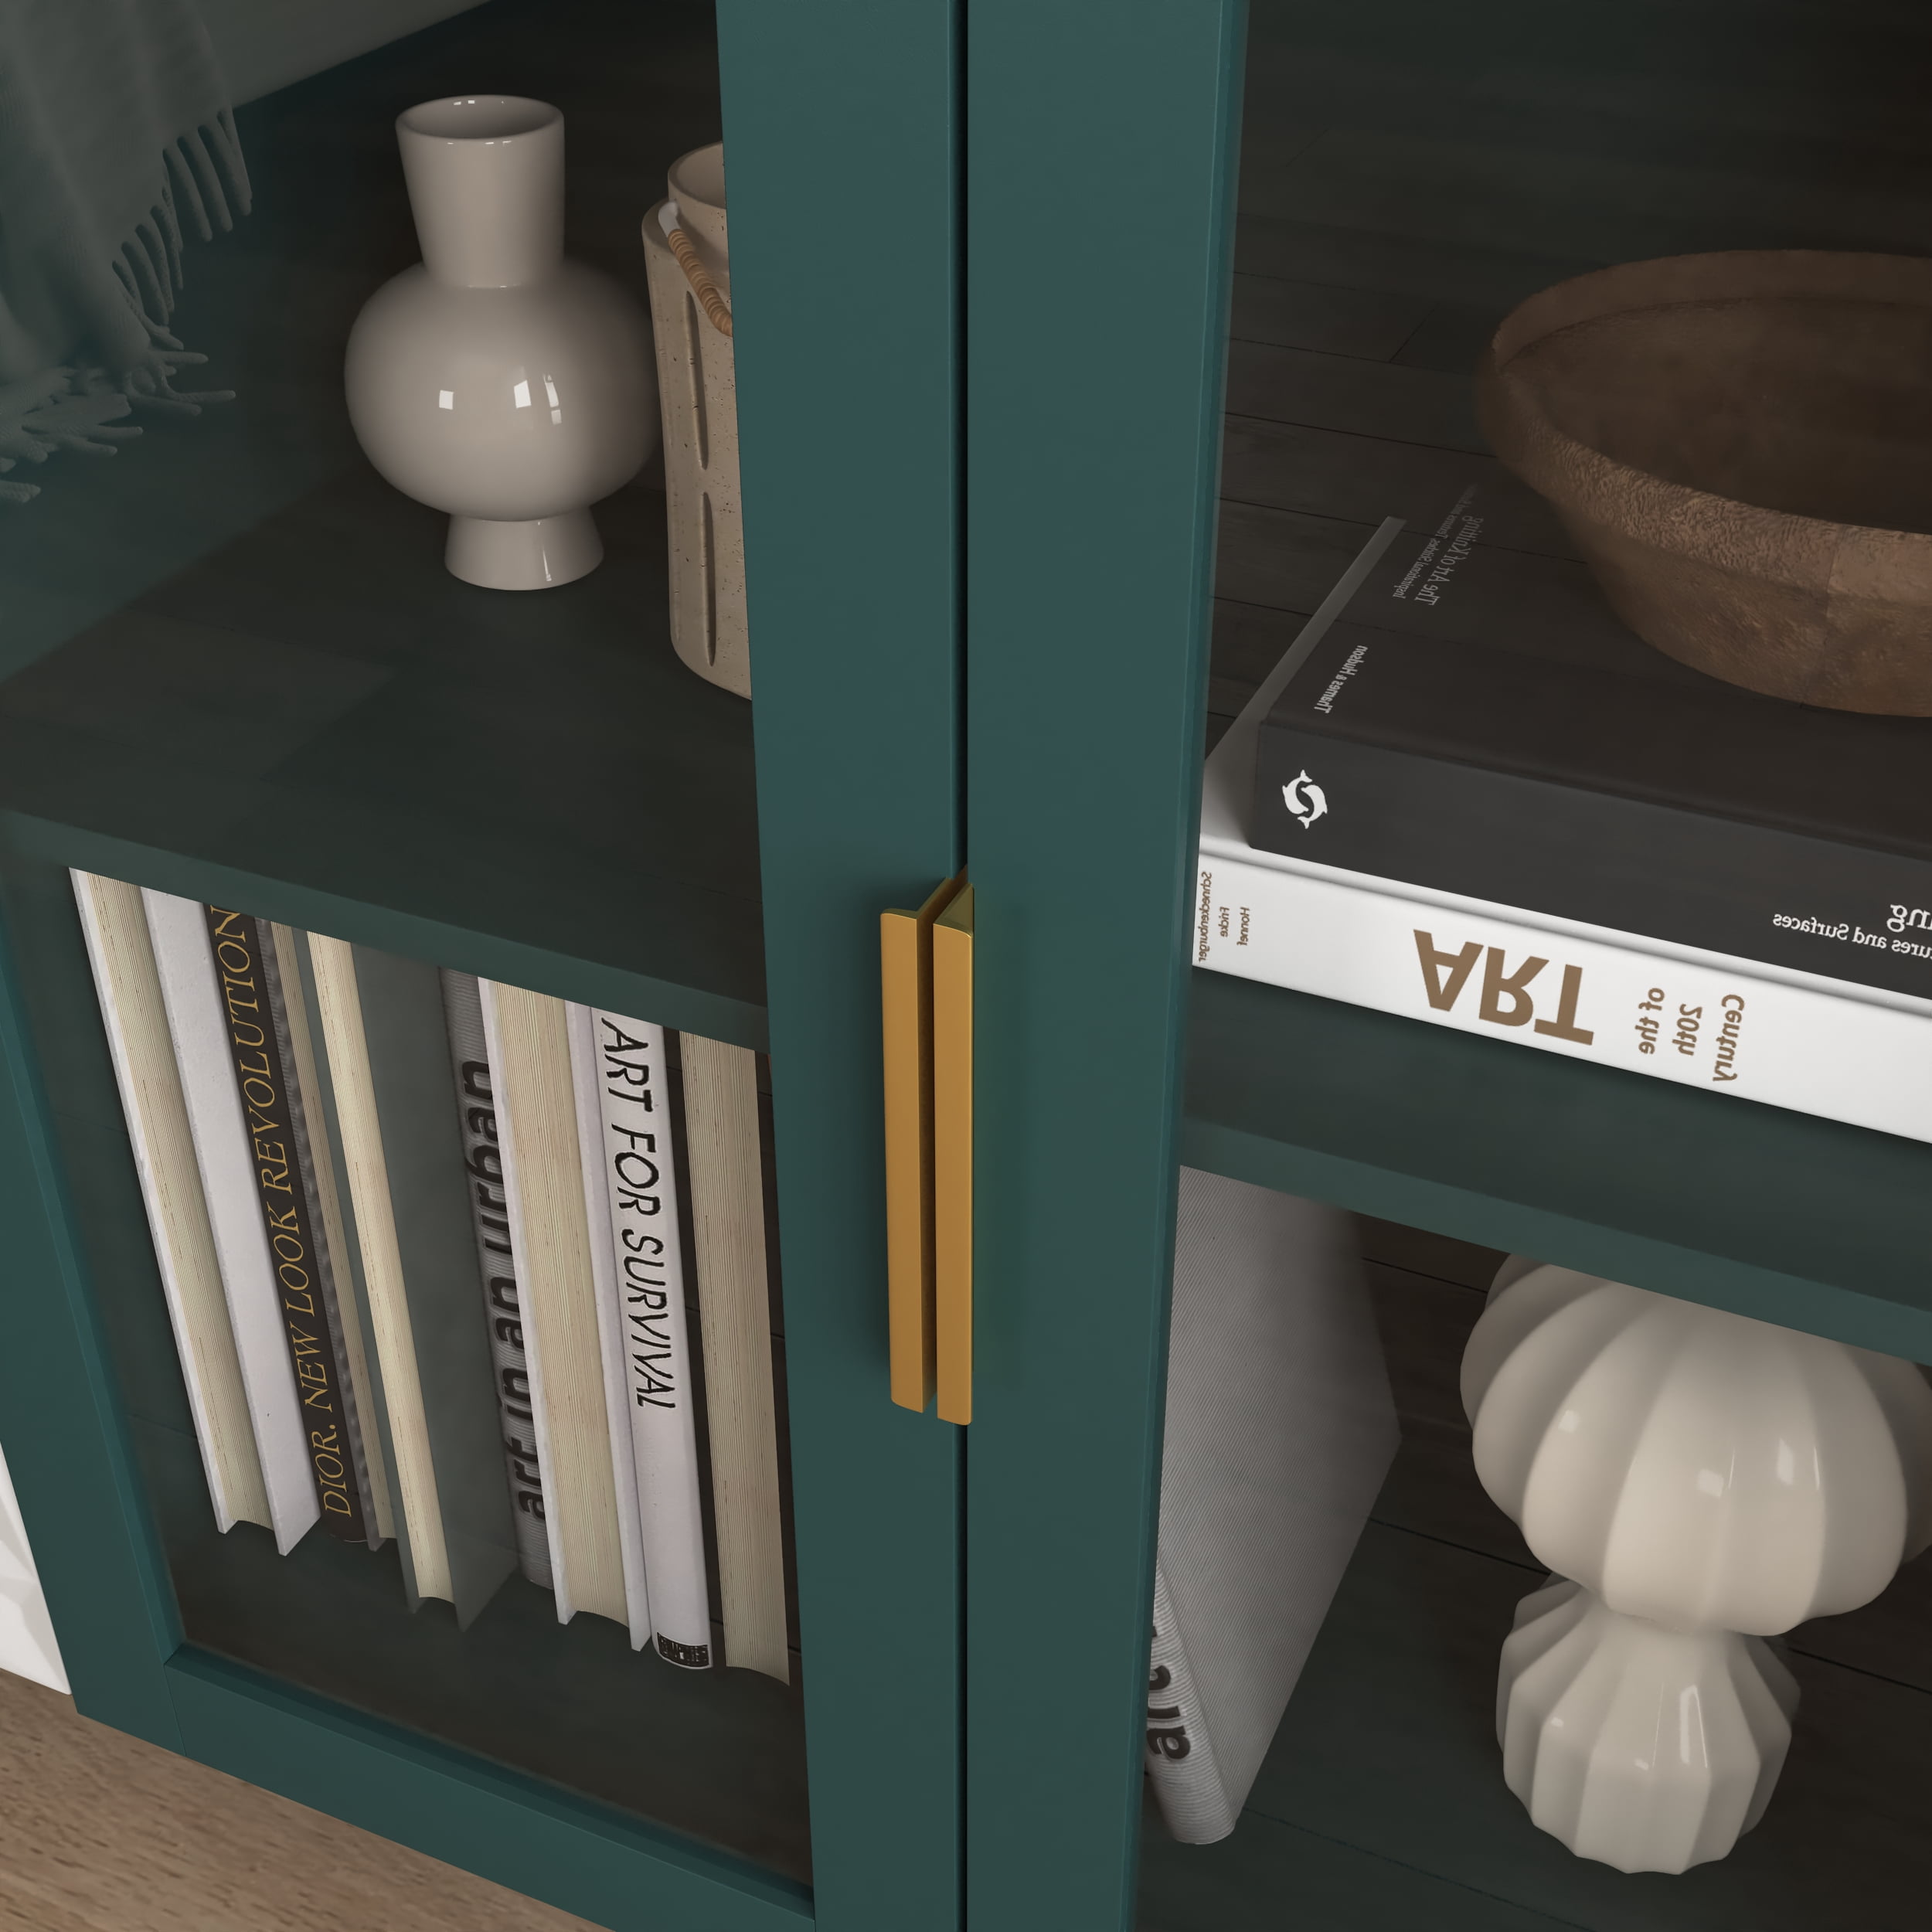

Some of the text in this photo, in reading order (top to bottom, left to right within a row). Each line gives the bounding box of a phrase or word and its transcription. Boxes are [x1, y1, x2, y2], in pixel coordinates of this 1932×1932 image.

[209, 905, 352, 1517] DIOR. NEW LOOK REVOLUTION
[600, 1017, 675, 1409] ART FOR SURVIVAL
